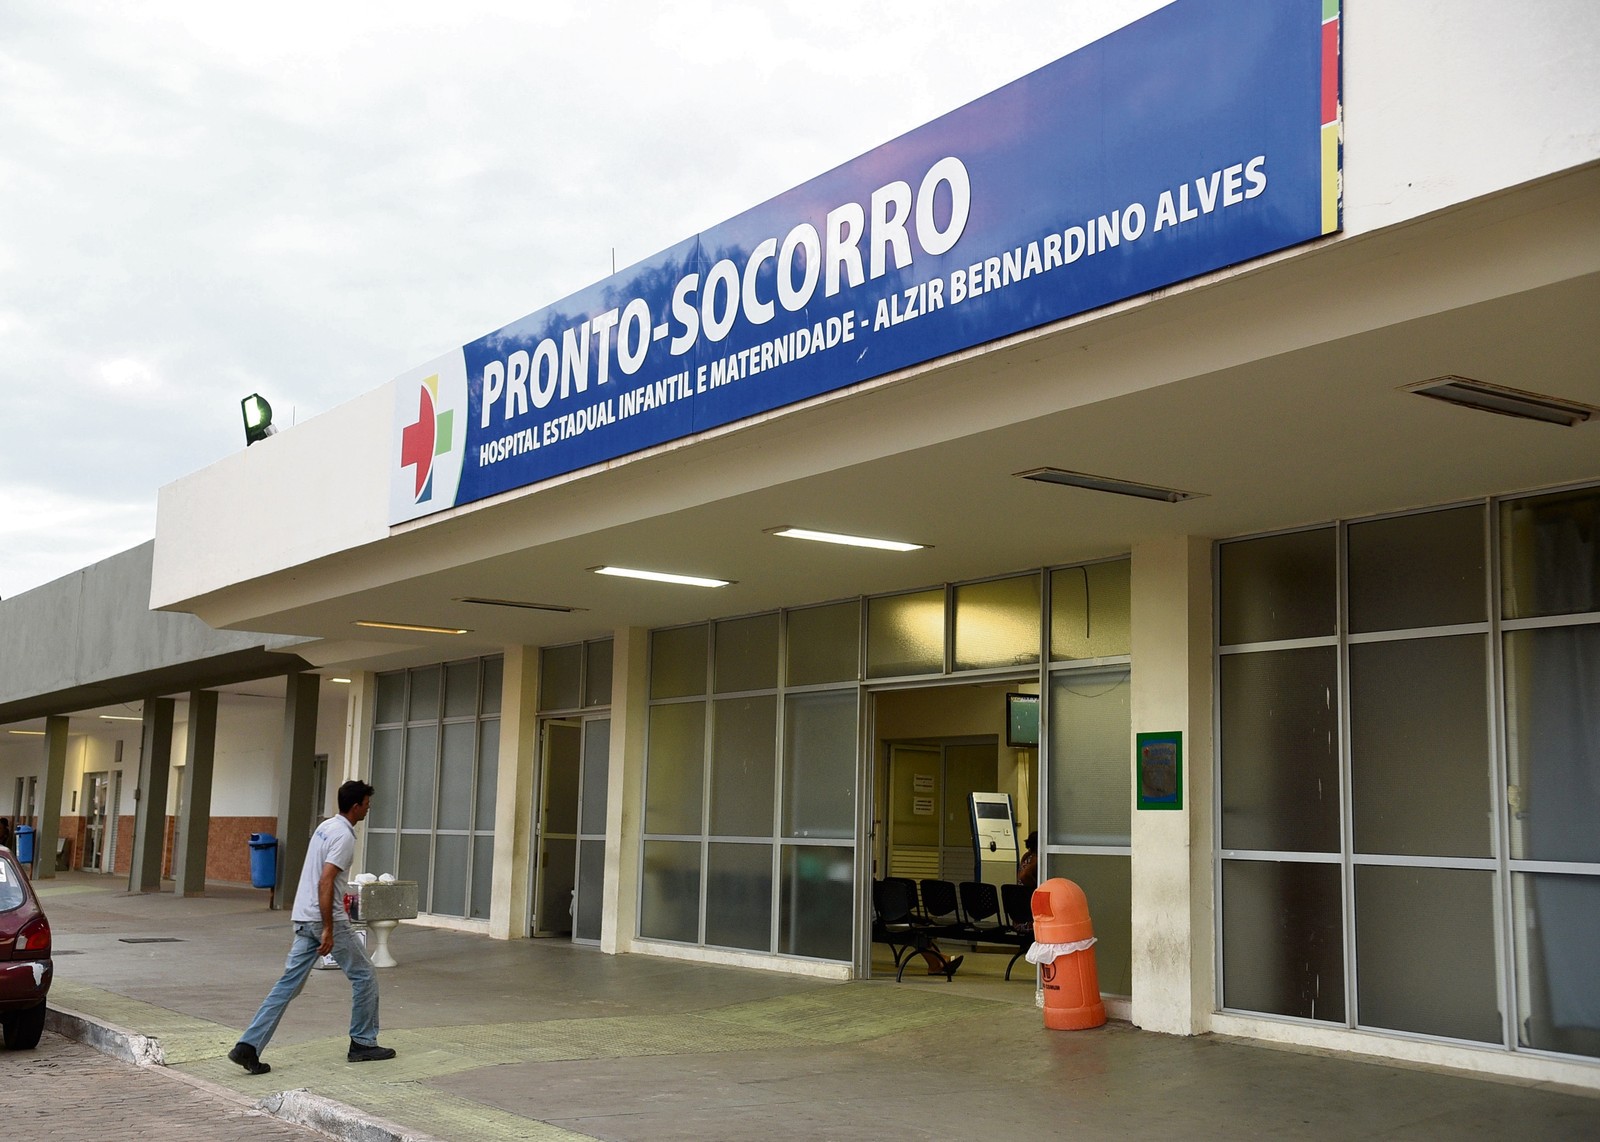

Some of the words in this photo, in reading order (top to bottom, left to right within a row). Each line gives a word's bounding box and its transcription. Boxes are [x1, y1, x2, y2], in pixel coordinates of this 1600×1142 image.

[479, 427, 541, 467] HOSPITAL
[542, 400, 617, 448] ESTADUAL
[618, 370, 693, 421] INFANTIL
[697, 365, 707, 394] E
[709, 310, 855, 390] MATERNIDADE
[873, 278, 944, 333] ALZIR
[950, 202, 1146, 306] BERNARDINO
[1153, 155, 1267, 233] ALVES
[480, 156, 971, 429] PRONTO-SOCORRO
